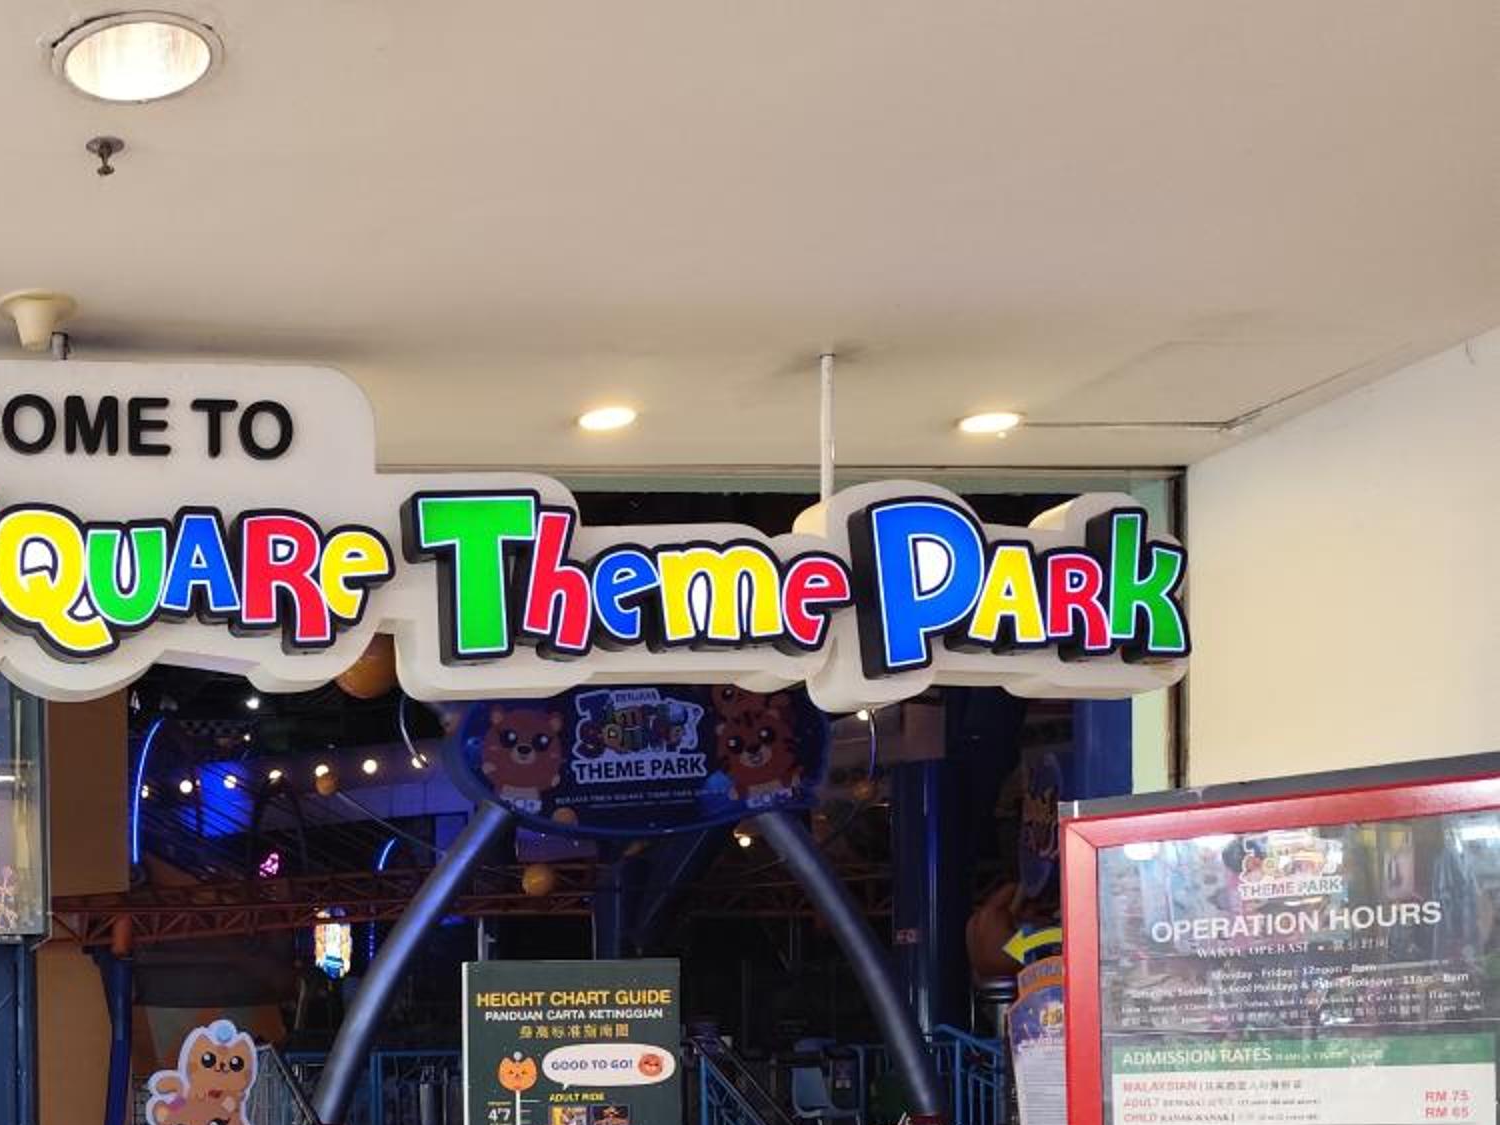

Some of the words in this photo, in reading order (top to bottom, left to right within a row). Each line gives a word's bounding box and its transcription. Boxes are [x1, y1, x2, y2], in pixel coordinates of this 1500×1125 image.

[193, 398, 294, 461] TO
[575, 761, 645, 781] THEME
[651, 757, 703, 777] PARK
[1152, 911, 1318, 943] OPERATION
[1330, 901, 1442, 931] HOURS
[476, 991, 546, 1008] HEIGHT
[549, 990, 610, 1006] CHART
[615, 988, 672, 1006] GUIDE
[485, 1009, 543, 1022] PANDUAN
[547, 1009, 585, 1021] CARTA
[589, 1007, 663, 1020] KETINGGIAN
[1123, 1050, 1216, 1066] ADMISSION
[1220, 1047, 1271, 1064] RATES
[551, 1059, 589, 1071] GOOD
[591, 1059, 607, 1070] TO
[610, 1058, 634, 1070] GO!
[1123, 1081, 1197, 1092] MALAYSIAN
[549, 1093, 580, 1102] ADULT
[1425, 1090, 1447, 1101] RM
[1451, 1090, 1470, 1101] 75
[1425, 1107, 1448, 1118] RM
